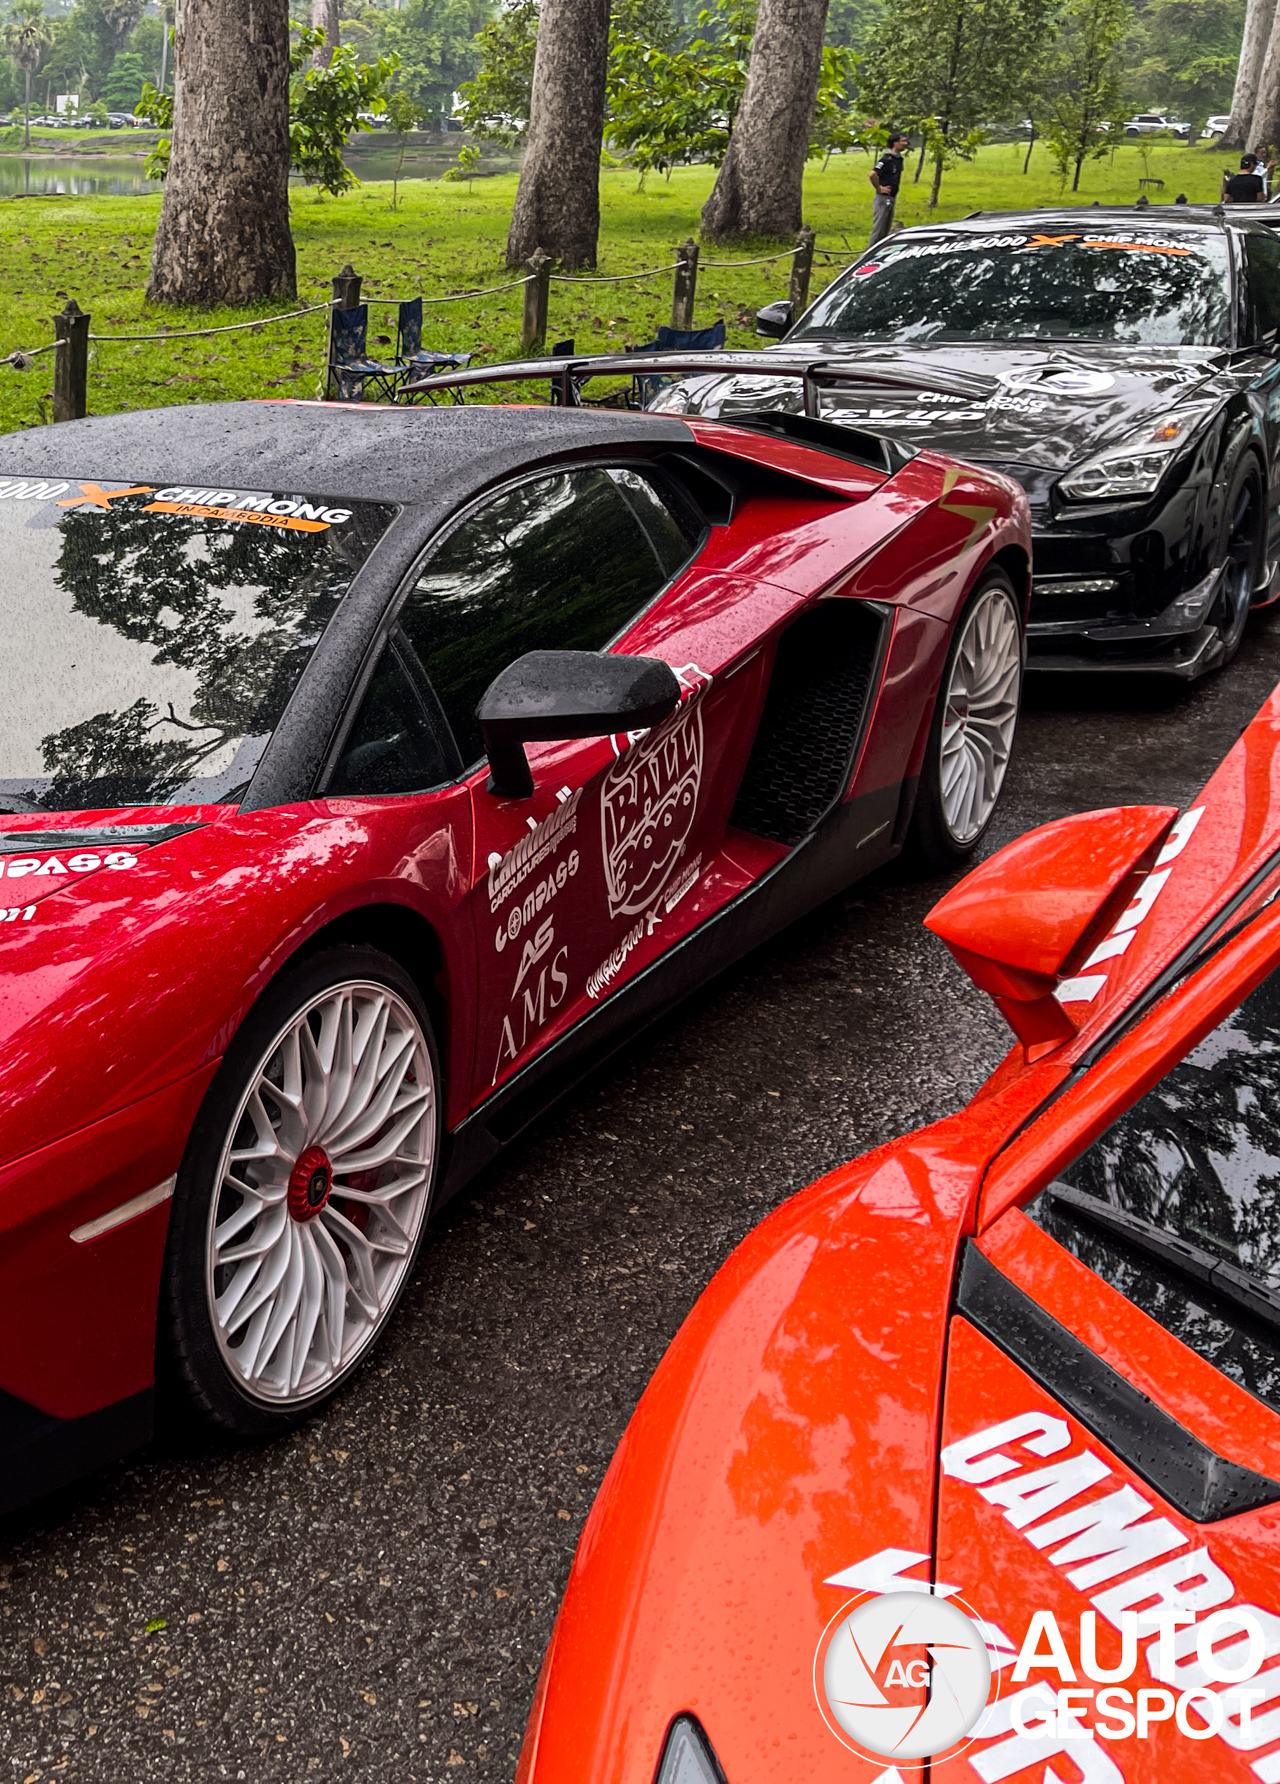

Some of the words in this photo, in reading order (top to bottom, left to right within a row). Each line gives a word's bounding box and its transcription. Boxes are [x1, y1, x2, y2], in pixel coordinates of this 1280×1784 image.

[154, 487, 239, 506] CHIP
[239, 497, 353, 524] MONG
[176, 505, 195, 513] IN
[196, 507, 289, 527] CAMBODIA
[491, 945, 569, 1086] AMS
